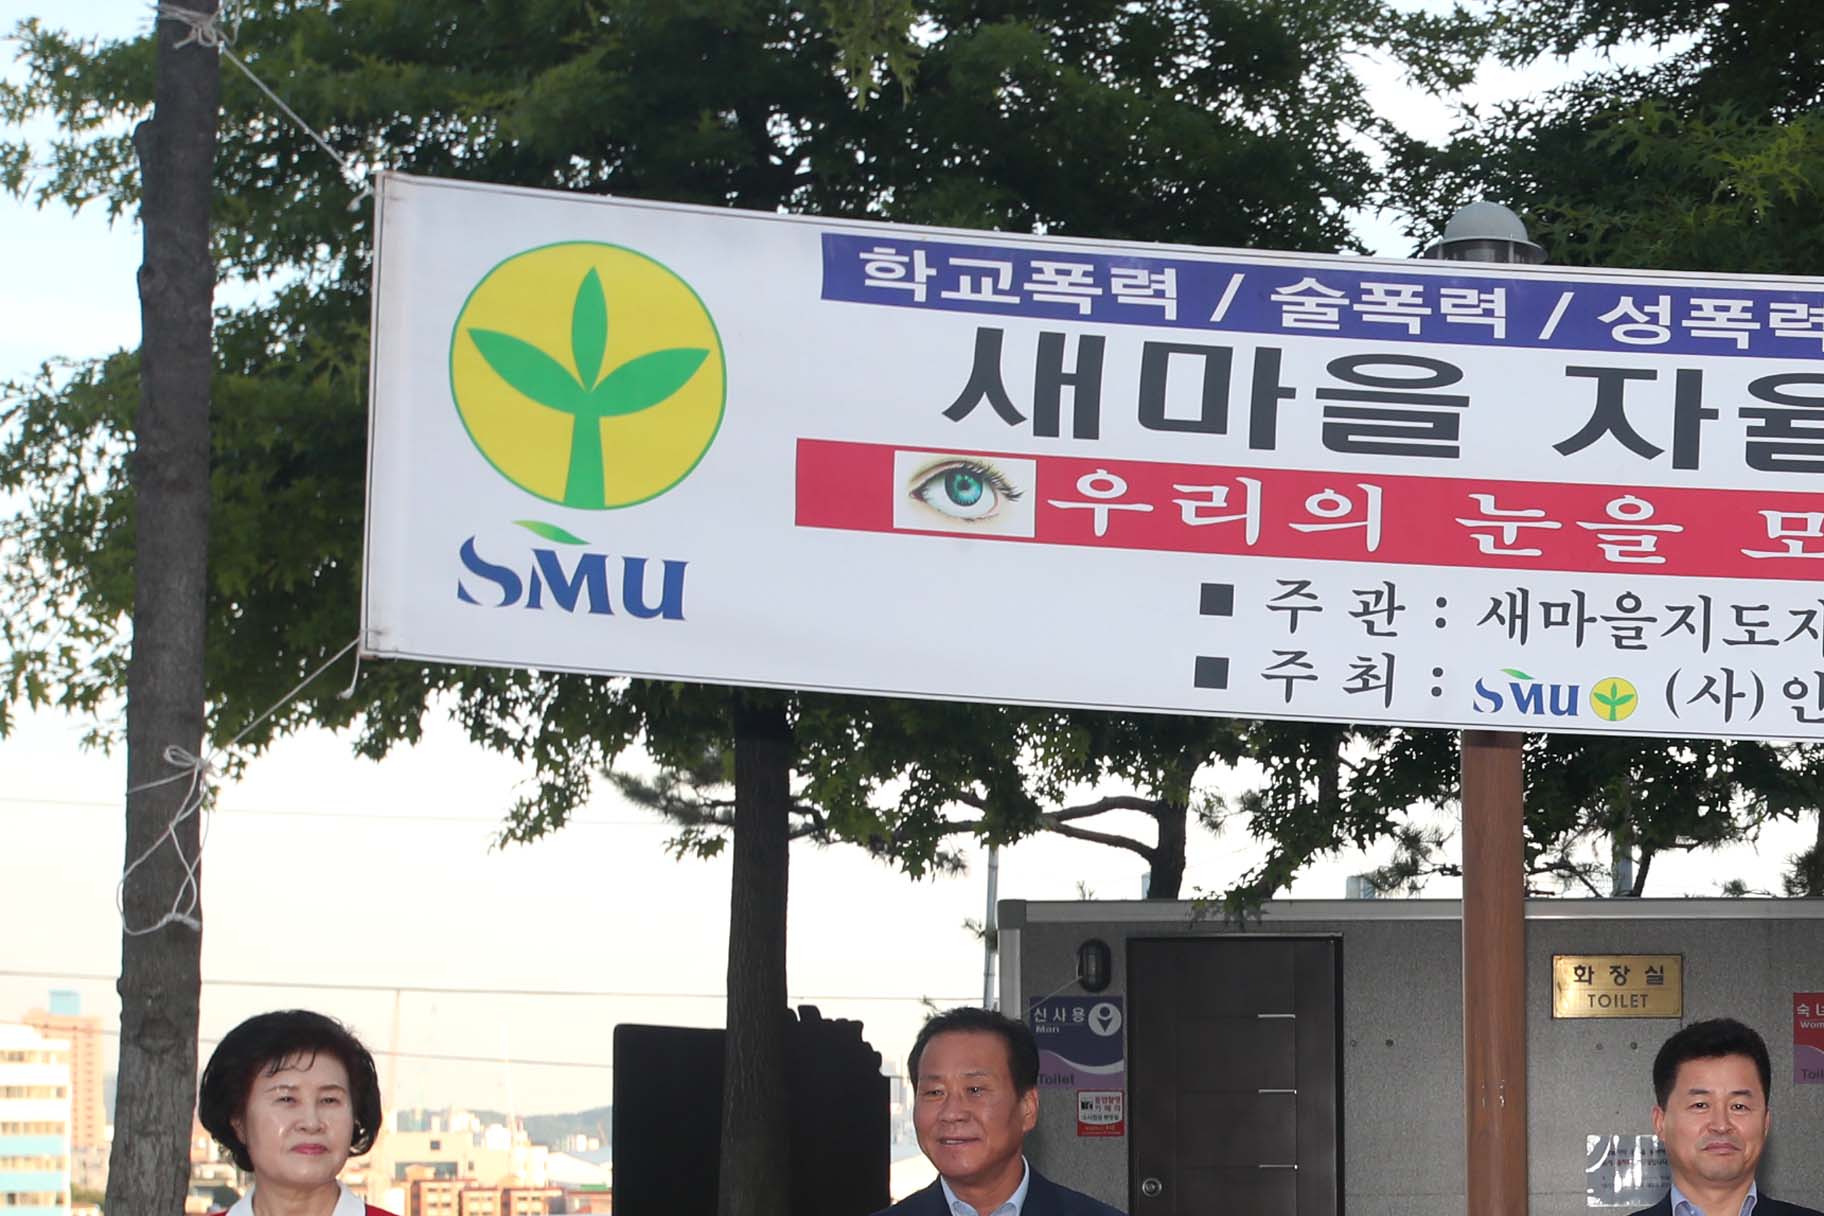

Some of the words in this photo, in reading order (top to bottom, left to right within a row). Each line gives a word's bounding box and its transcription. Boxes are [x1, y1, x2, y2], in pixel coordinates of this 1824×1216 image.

[859, 246, 1177, 321] 학교폭력
[1270, 277, 1506, 339] 술폭력
[941, 326, 1470, 459] 새마을
[1047, 468, 1383, 552] 우리의
[1455, 493, 1684, 564] 눈을
[457, 536, 688, 621] SMU
[1473, 678, 1580, 717] SMU
[1587, 993, 1649, 1009] TOILET
